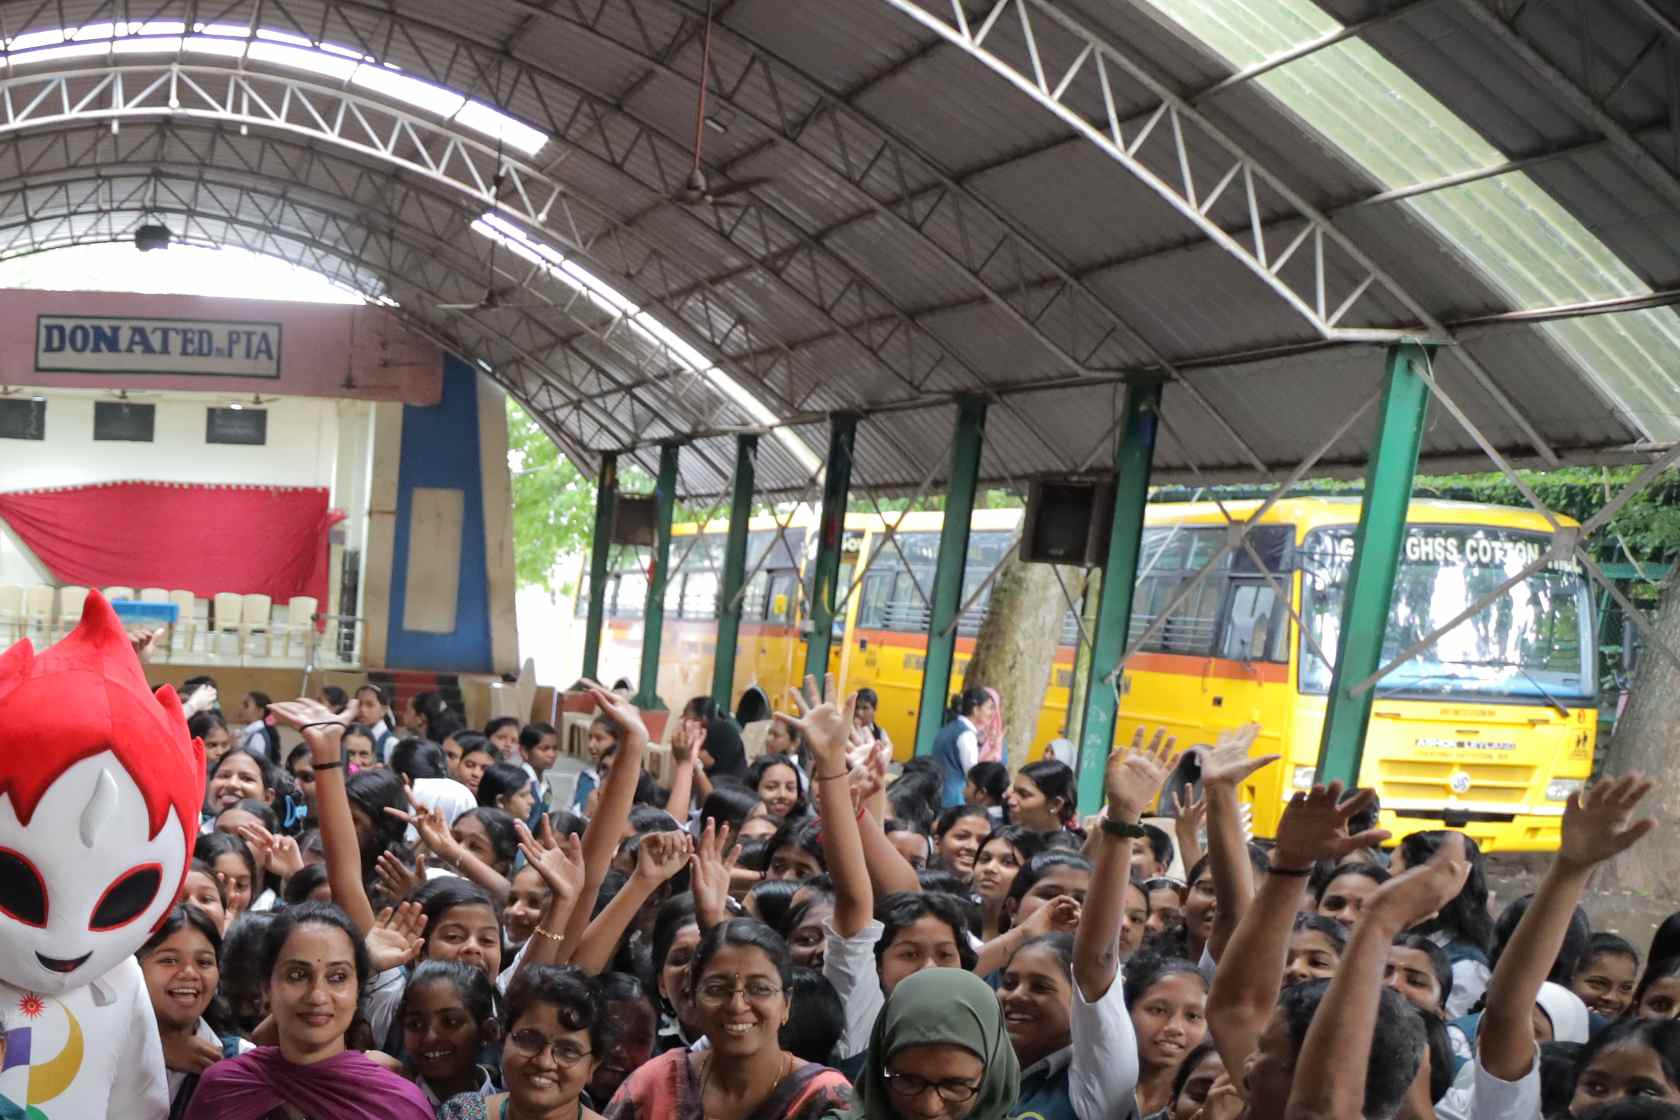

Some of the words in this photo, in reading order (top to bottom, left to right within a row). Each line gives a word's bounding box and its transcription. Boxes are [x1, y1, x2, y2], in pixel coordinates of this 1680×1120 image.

[43, 324, 213, 357] DONATED
[228, 330, 274, 360] PTA
[1406, 537, 1457, 561] GHSS
[1465, 539, 1539, 562] COTTON
